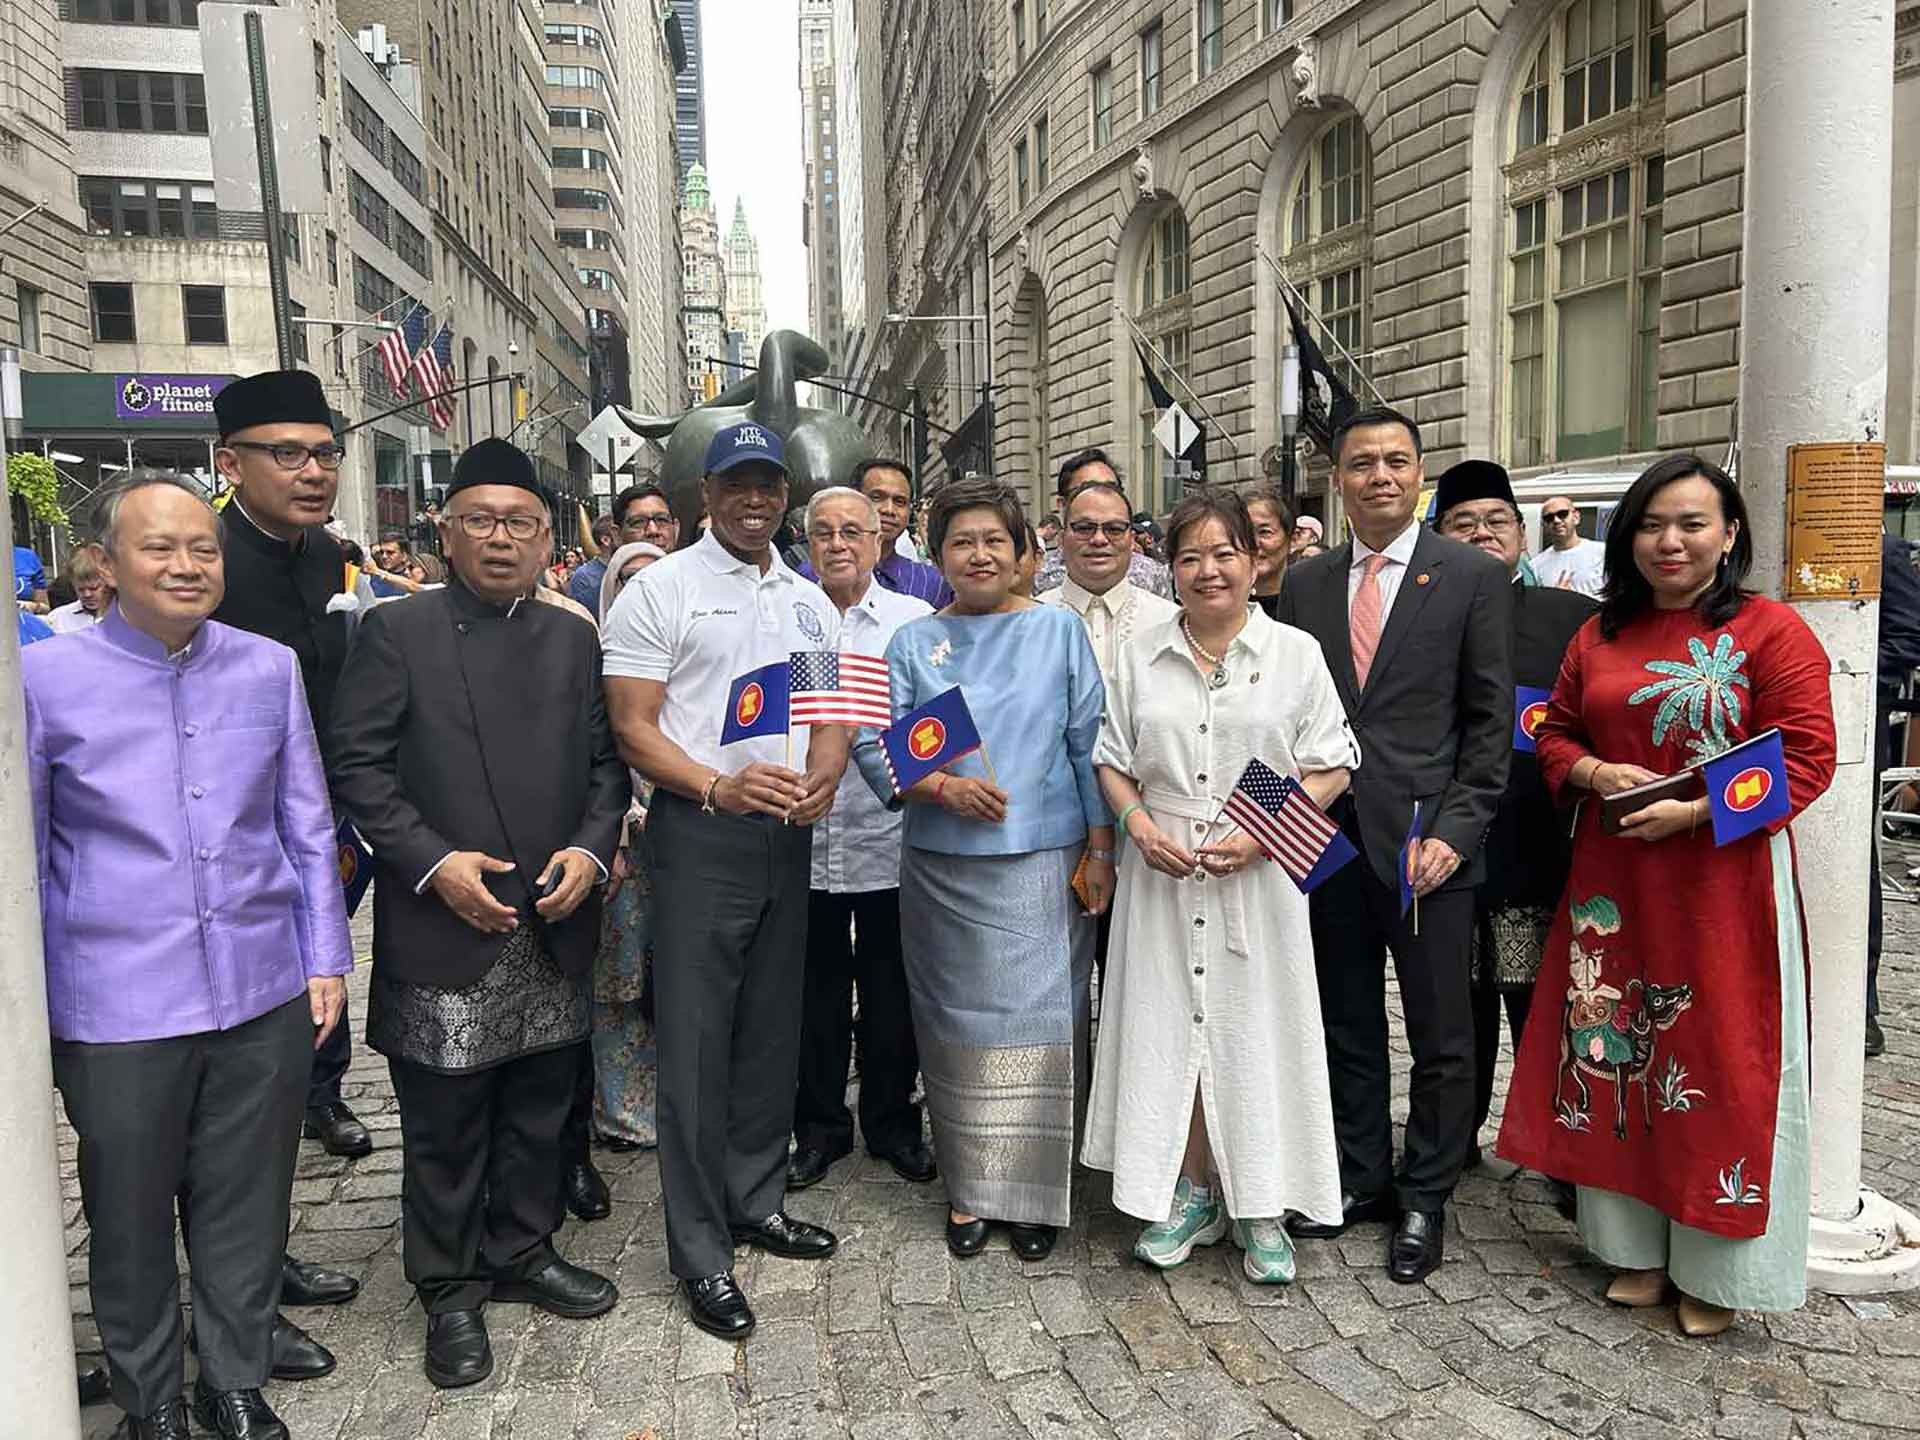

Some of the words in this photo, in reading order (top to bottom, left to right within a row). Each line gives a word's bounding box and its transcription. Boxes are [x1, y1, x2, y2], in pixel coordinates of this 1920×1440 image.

[152, 383, 212, 401] planet
[161, 398, 214, 412] fitnes
[739, 426, 762, 437] NYC
[734, 434, 769, 448] MAYOR
